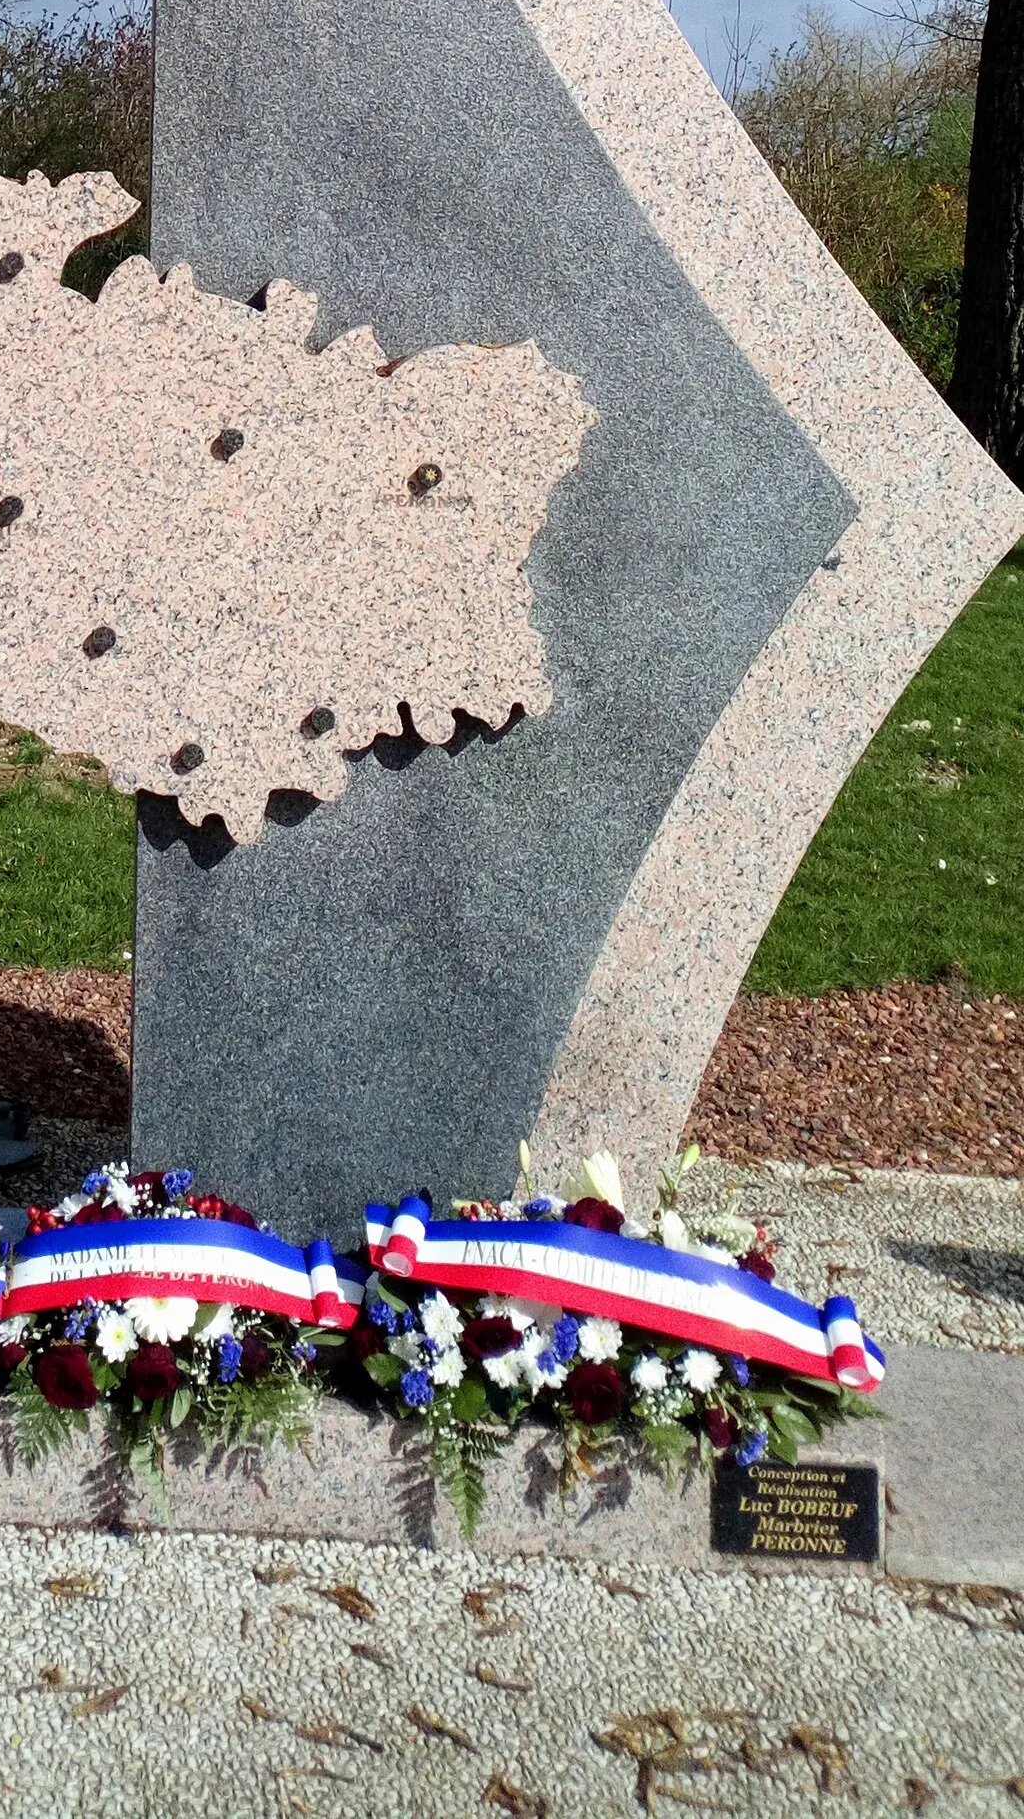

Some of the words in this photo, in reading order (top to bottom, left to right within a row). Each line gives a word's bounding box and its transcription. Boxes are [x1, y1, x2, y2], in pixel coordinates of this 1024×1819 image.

[50, 1244, 133, 1267] MADAME
[462, 1240, 524, 1267] FNACA
[50, 1270, 73, 1284] DE
[79, 1266, 102, 1281] LA
[748, 1465, 829, 1483] Conception
[832, 1471, 847, 1484] et
[738, 1496, 773, 1513] Luc
[777, 1498, 858, 1519] BOBEUF
[757, 1516, 839, 1536] Marbrier
[751, 1533, 847, 1555] PERONNE
